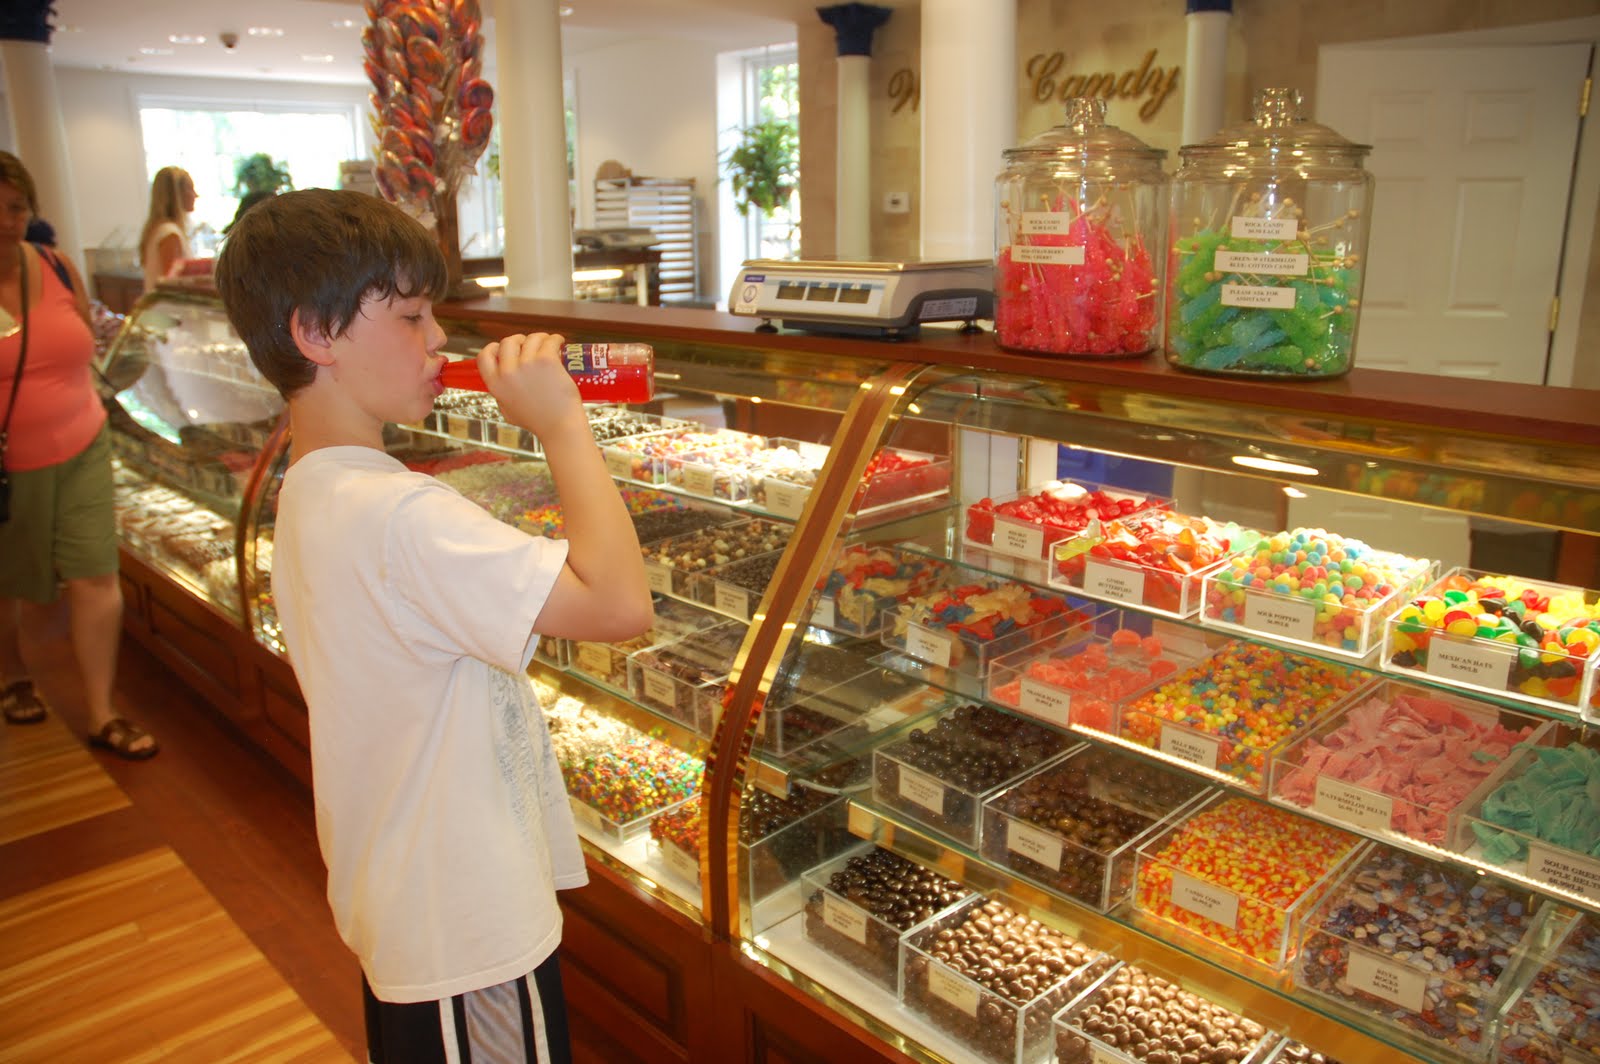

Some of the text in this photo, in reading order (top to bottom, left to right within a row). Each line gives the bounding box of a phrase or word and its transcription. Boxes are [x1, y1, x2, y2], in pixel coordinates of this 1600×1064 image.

[1026, 48, 1180, 122] Candy
[1438, 652, 1493, 670] MEXICAN HATS
[1539, 866, 1571, 881] APPLE
[1543, 859, 1600, 881] SOUR GREE
